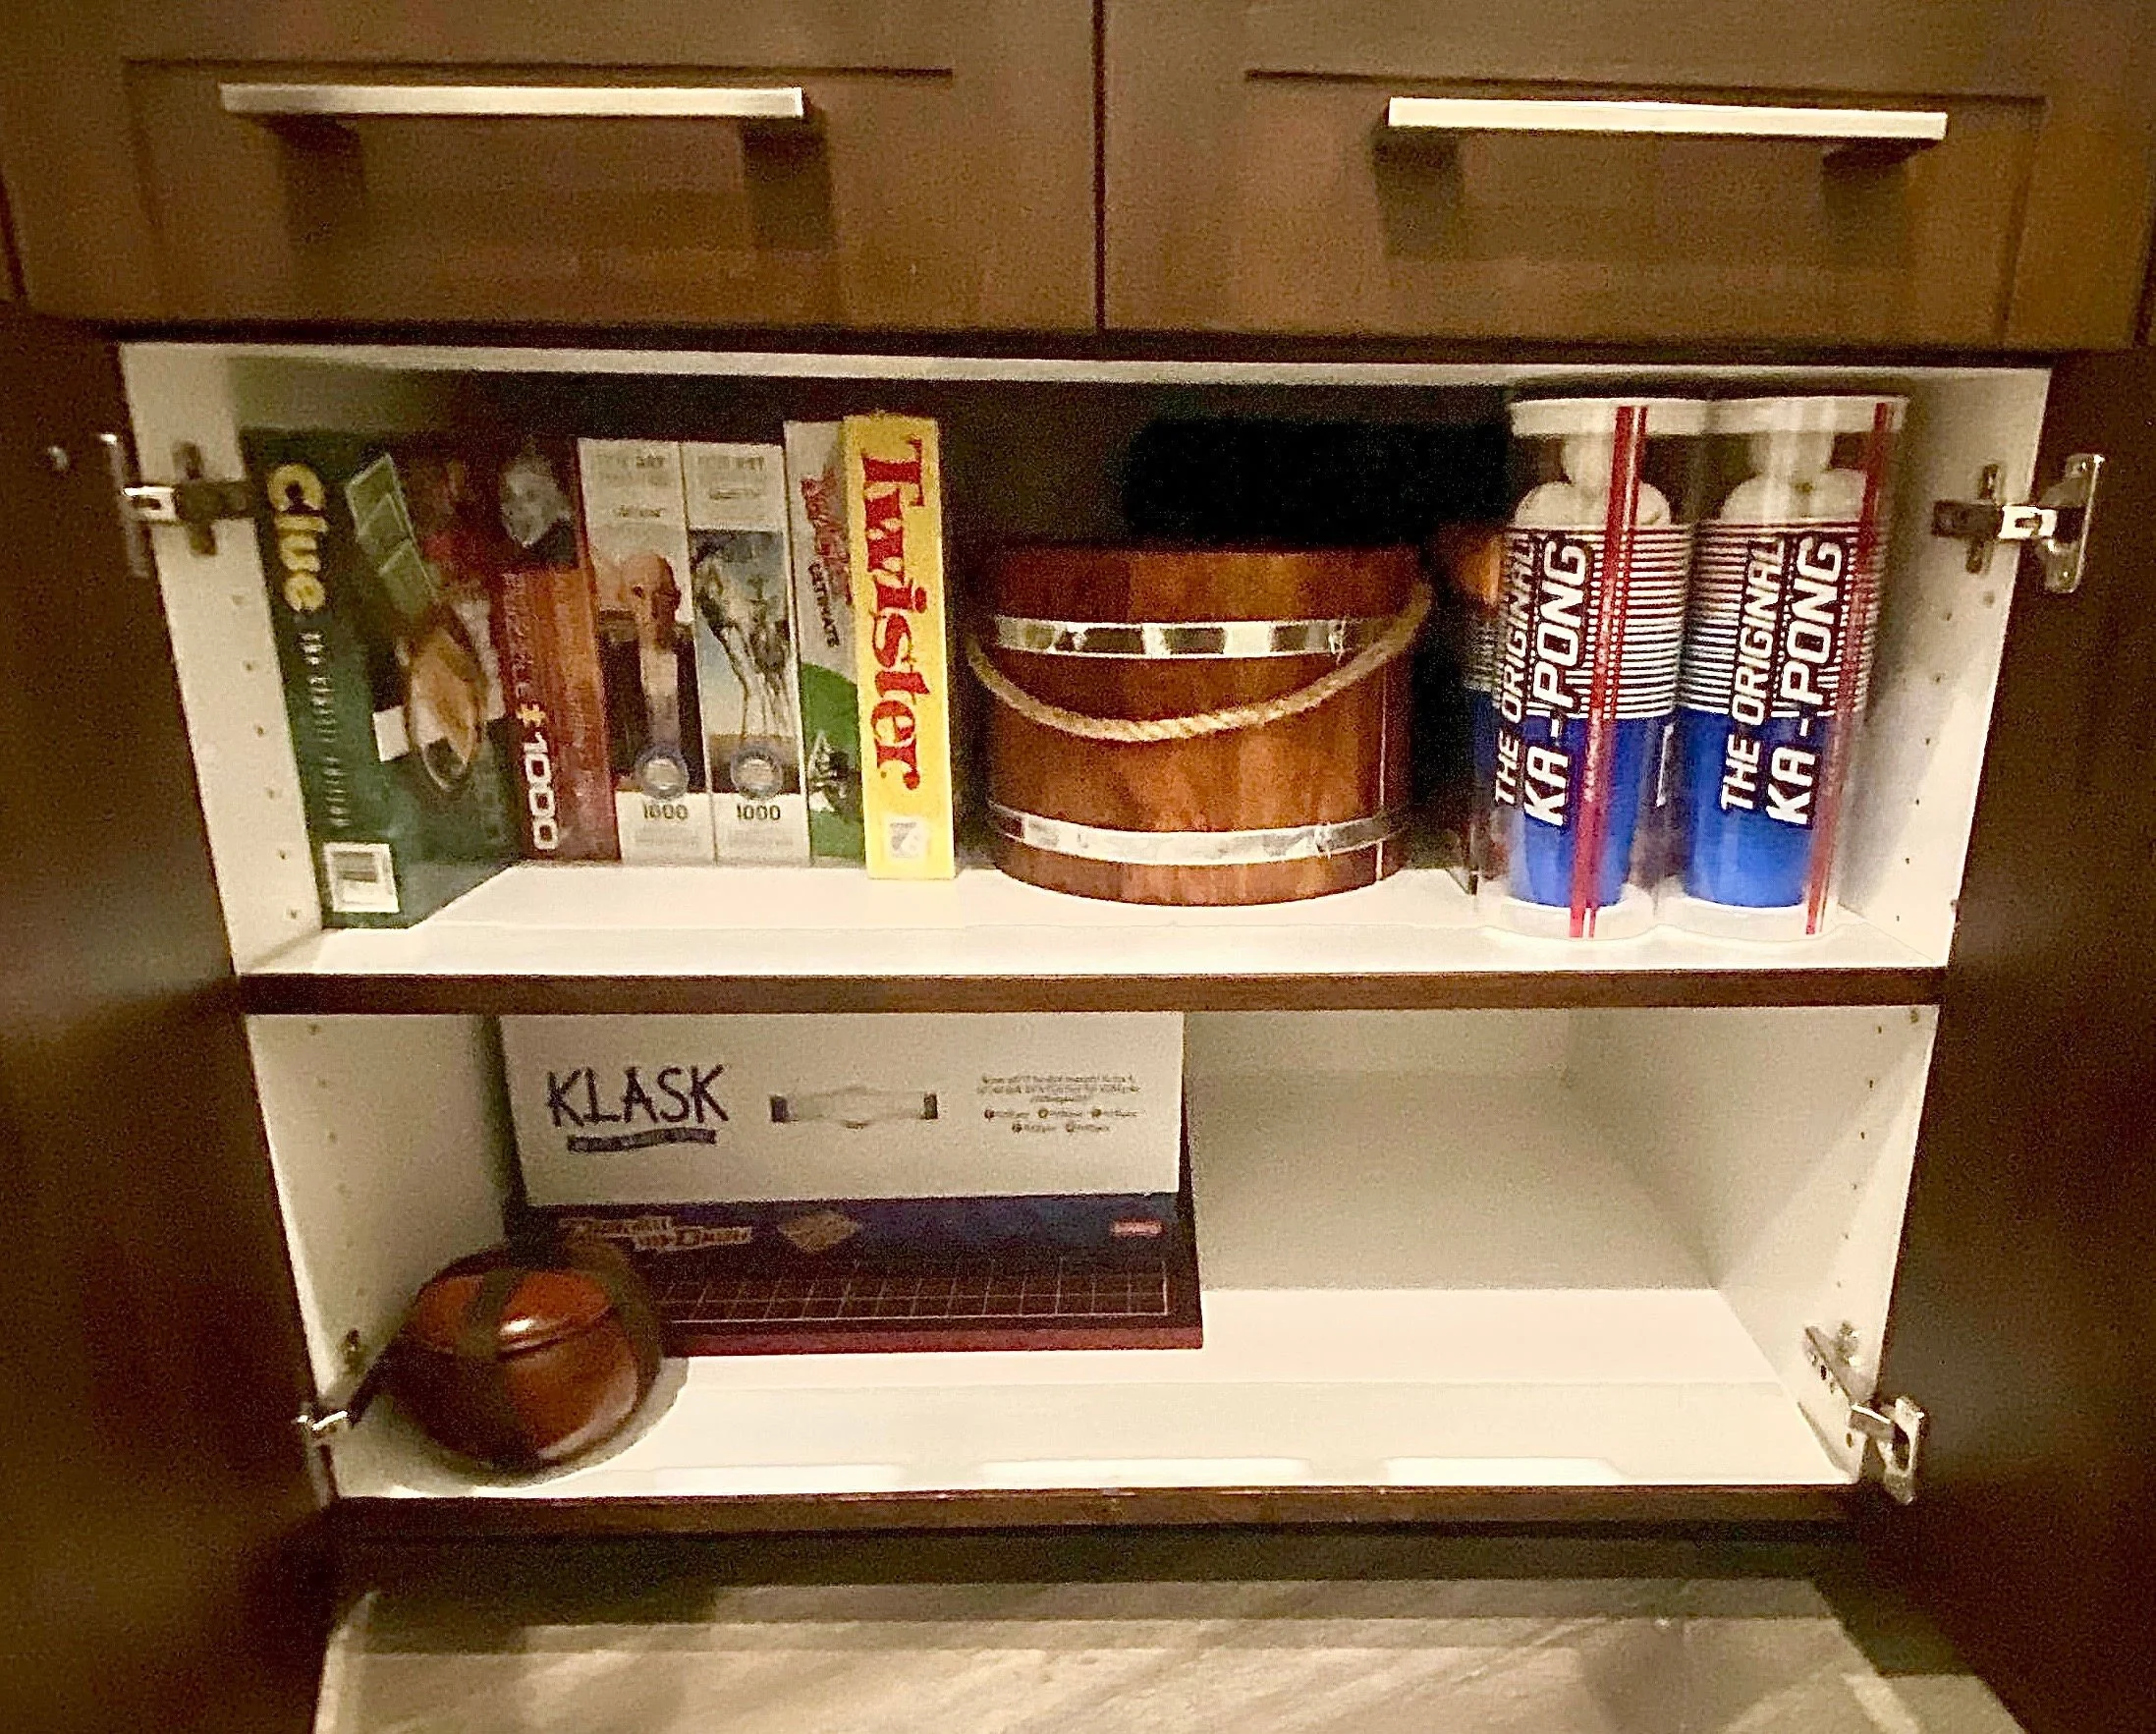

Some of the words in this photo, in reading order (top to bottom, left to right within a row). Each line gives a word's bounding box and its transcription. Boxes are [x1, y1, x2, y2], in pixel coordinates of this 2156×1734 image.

[266, 462, 329, 613] Clue
[860, 435, 930, 791] Twister
[1500, 532, 1535, 723] ORIGINAL
[1733, 537, 1785, 727] ORIGINAL
[522, 731, 560, 851] 1000
[736, 804, 782, 821] 1000
[1494, 732, 1521, 806] THE
[1721, 734, 1759, 810] THE
[547, 1063, 730, 1127] KLASK
